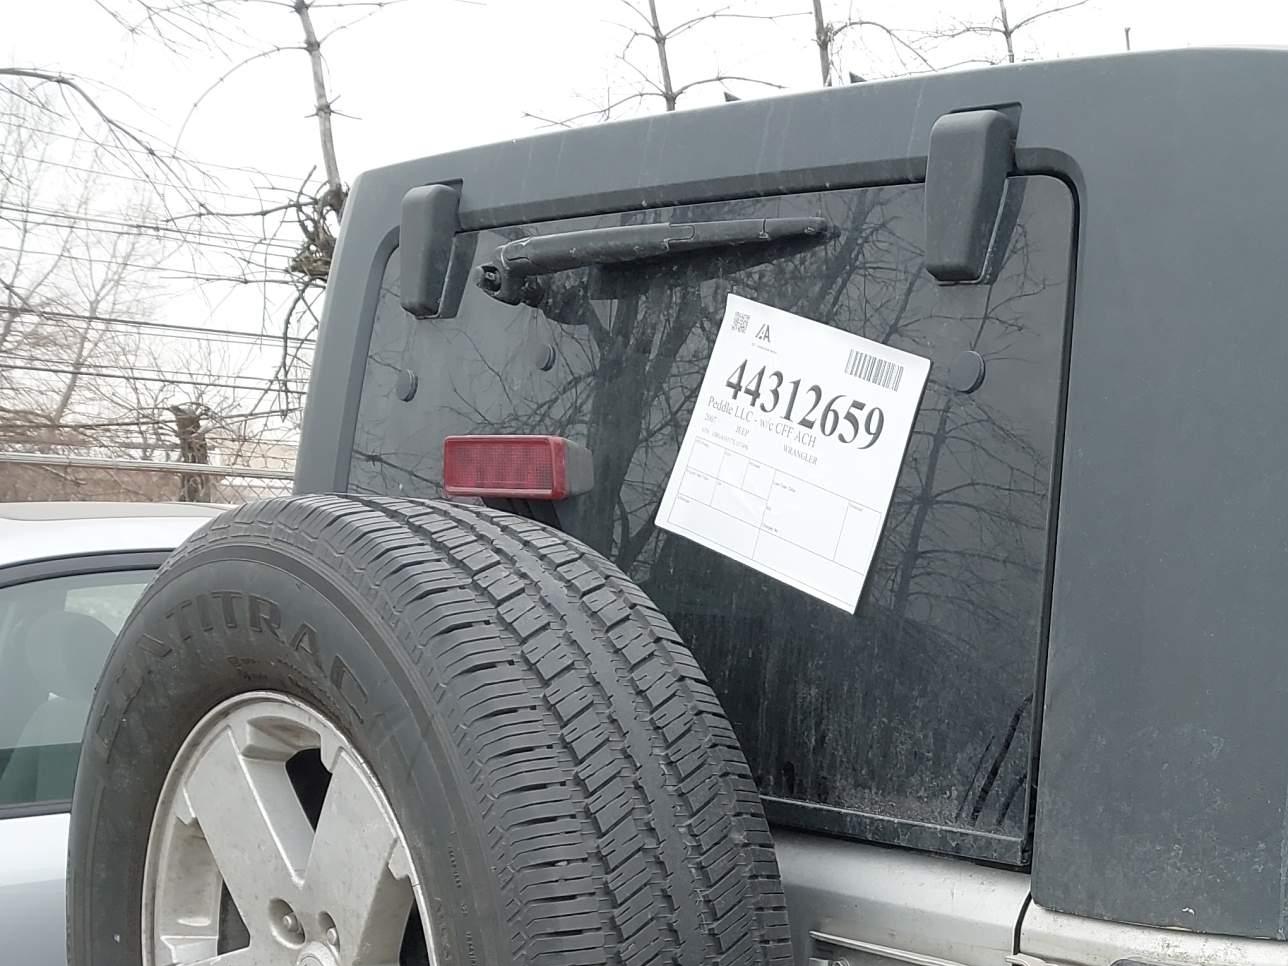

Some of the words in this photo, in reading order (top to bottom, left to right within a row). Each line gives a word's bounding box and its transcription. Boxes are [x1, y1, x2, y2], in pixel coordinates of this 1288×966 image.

[708, 395, 734, 416] Peddle
[734, 403, 755, 423] LLC
[794, 430, 817, 449] ACH
[725, 358, 885, 450] 44312659
[783, 443, 818, 466] WRANGLER
